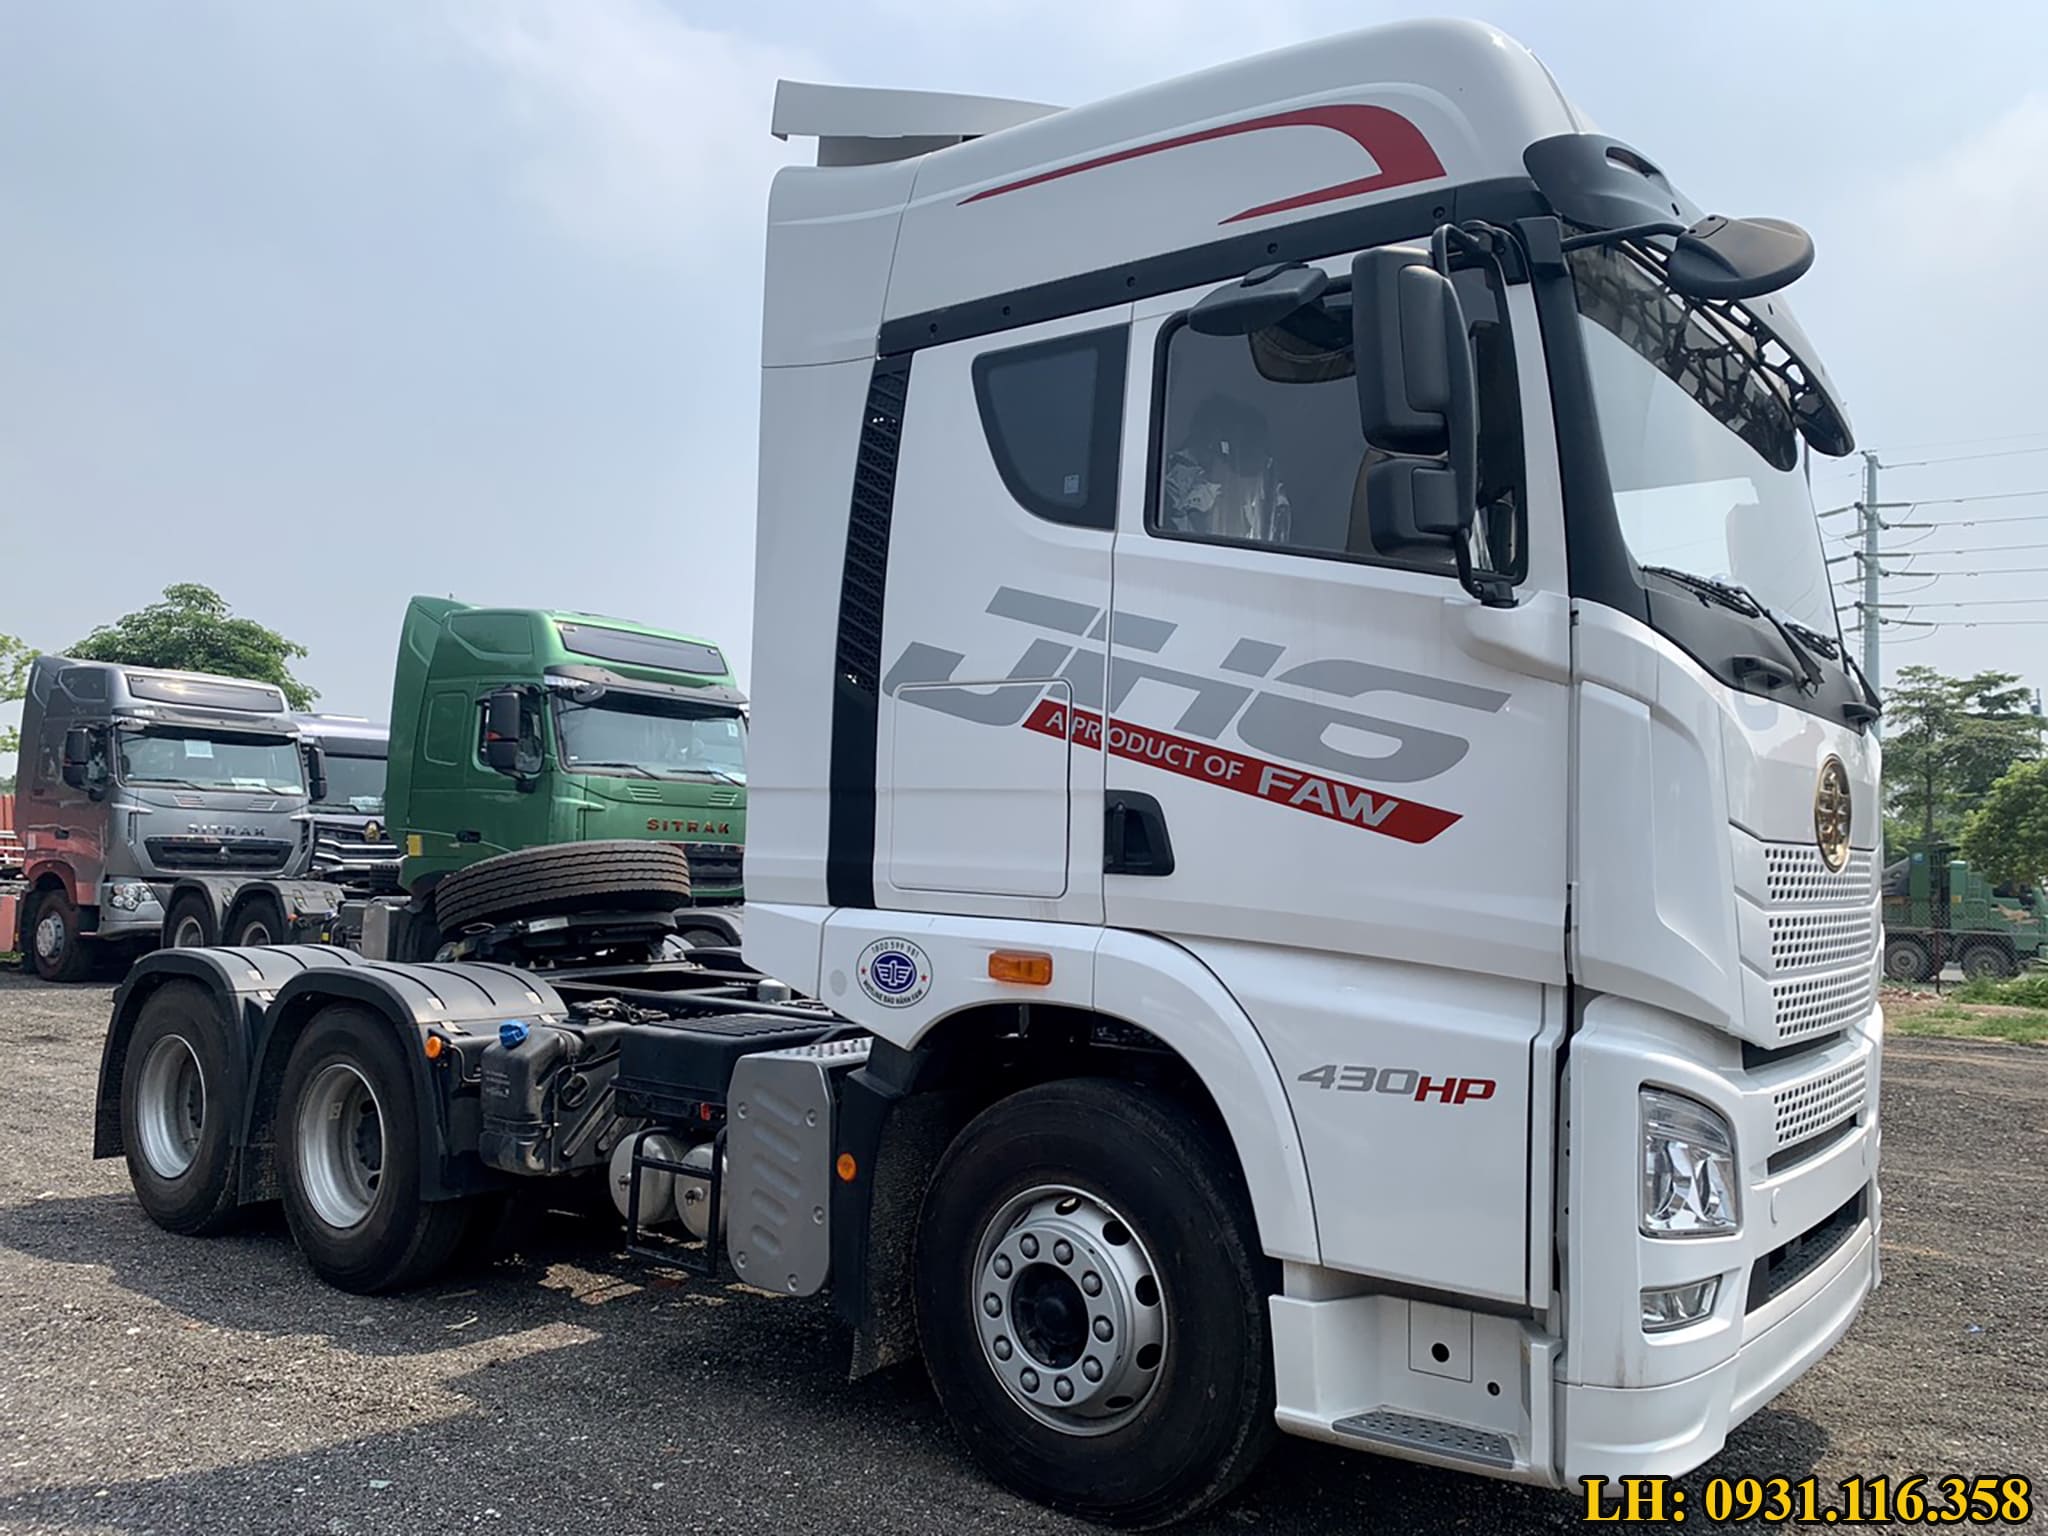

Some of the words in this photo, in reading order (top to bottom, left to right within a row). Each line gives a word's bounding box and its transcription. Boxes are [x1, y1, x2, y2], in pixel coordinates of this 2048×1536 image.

[1046, 710, 1064, 731] A
[1071, 716, 1200, 770] PRODUCT
[1203, 755, 1245, 781] OF
[1256, 765, 1400, 827] FAW
[187, 823, 266, 837] SITRAK
[646, 818, 730, 834] SITRAK
[1297, 1064, 1497, 1105] 430HP
